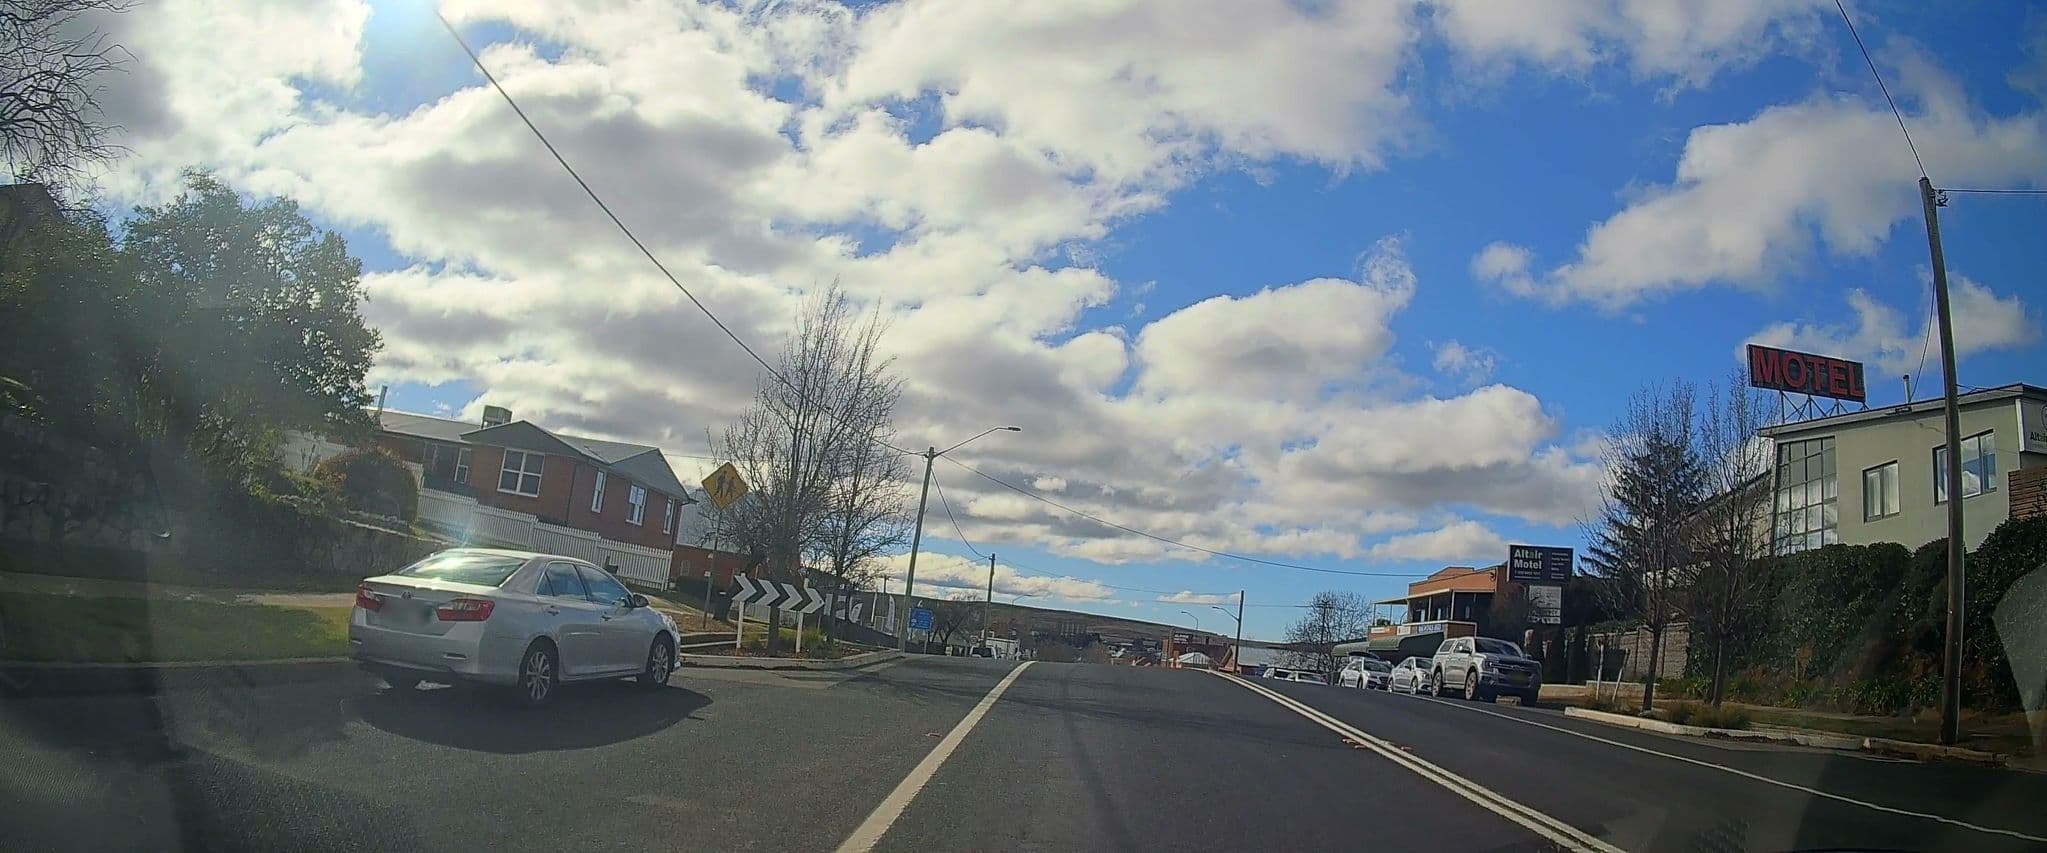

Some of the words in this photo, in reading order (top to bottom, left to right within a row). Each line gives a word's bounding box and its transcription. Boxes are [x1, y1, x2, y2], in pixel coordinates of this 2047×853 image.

[1754, 347, 1865, 397] MOTEL
[1514, 548, 1543, 559] Altair
[1514, 559, 1542, 569] Motel
